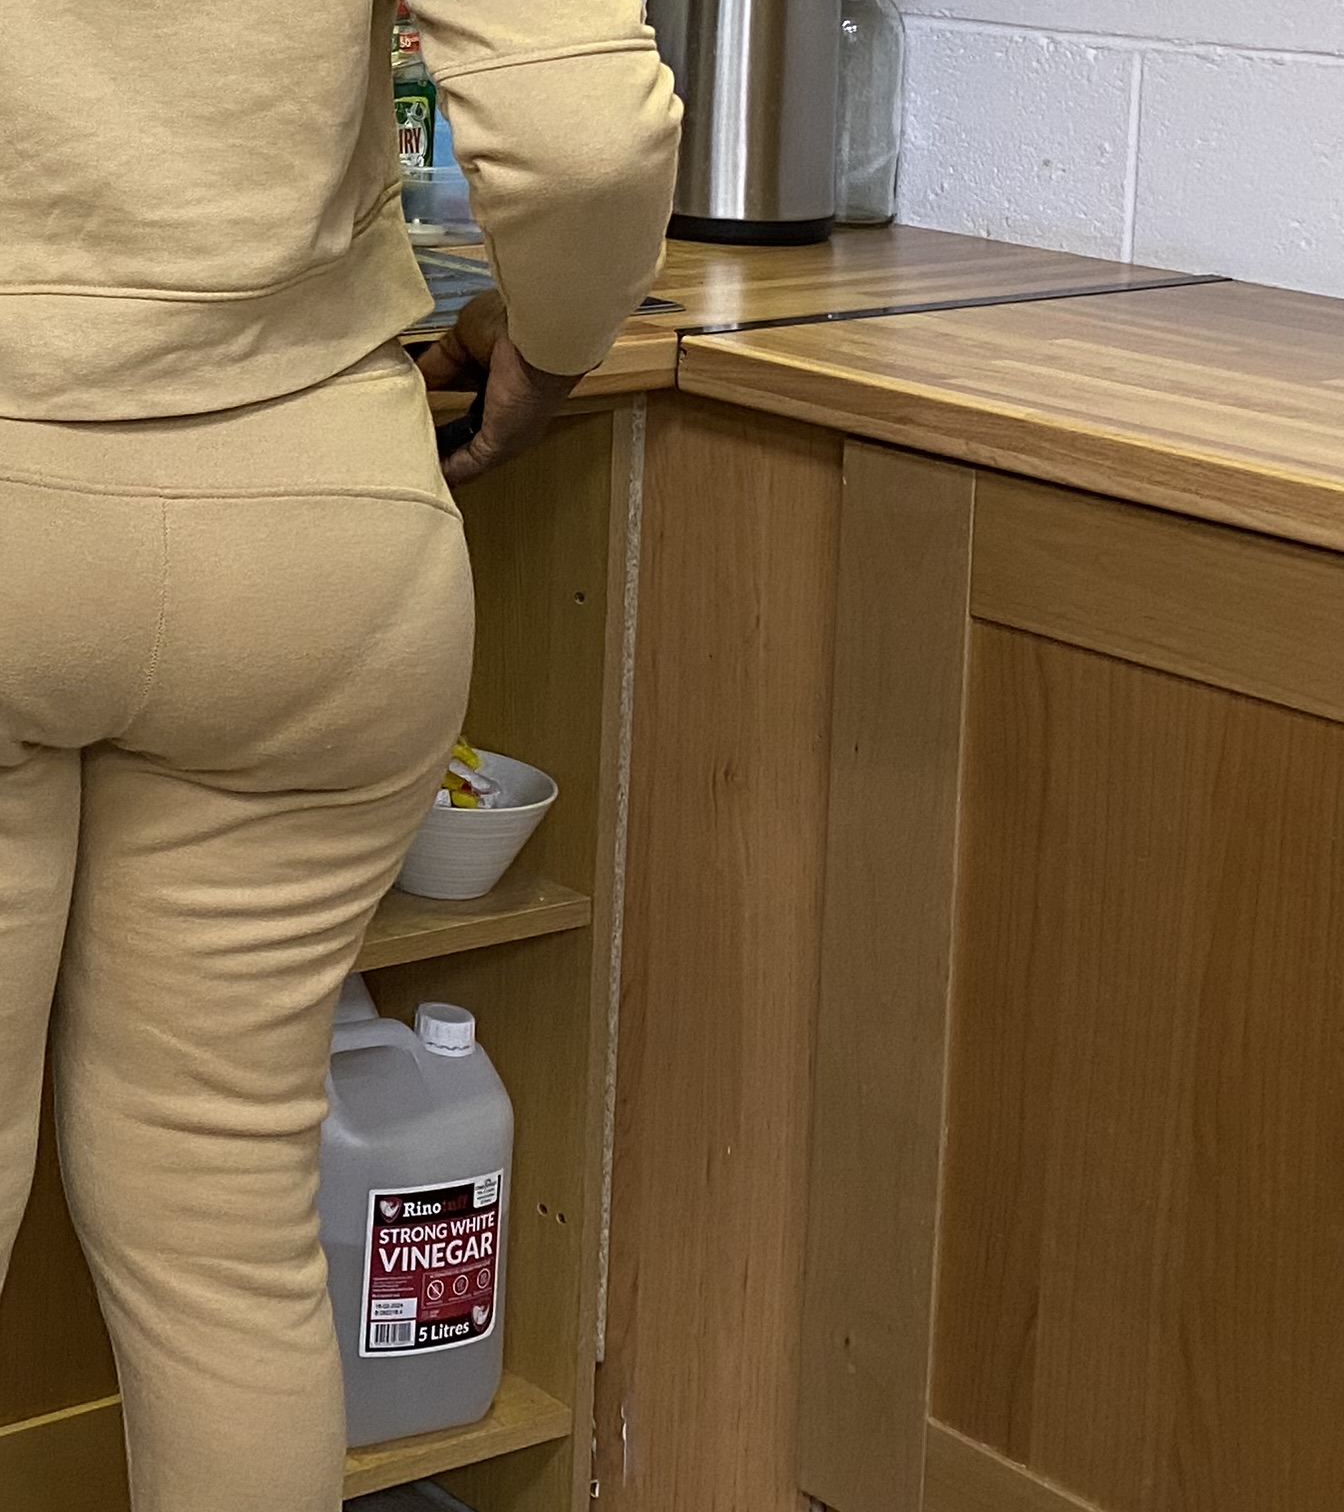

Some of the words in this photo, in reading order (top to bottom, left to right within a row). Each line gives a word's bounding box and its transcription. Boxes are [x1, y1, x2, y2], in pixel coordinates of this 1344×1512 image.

[399, 127, 422, 154] IRY
[379, 1223, 448, 1245] STRONG
[450, 1211, 496, 1237] WHITE
[378, 1231, 494, 1273] VINEGAR
[418, 1326, 428, 1342] 5
[430, 1321, 470, 1340] Litres
